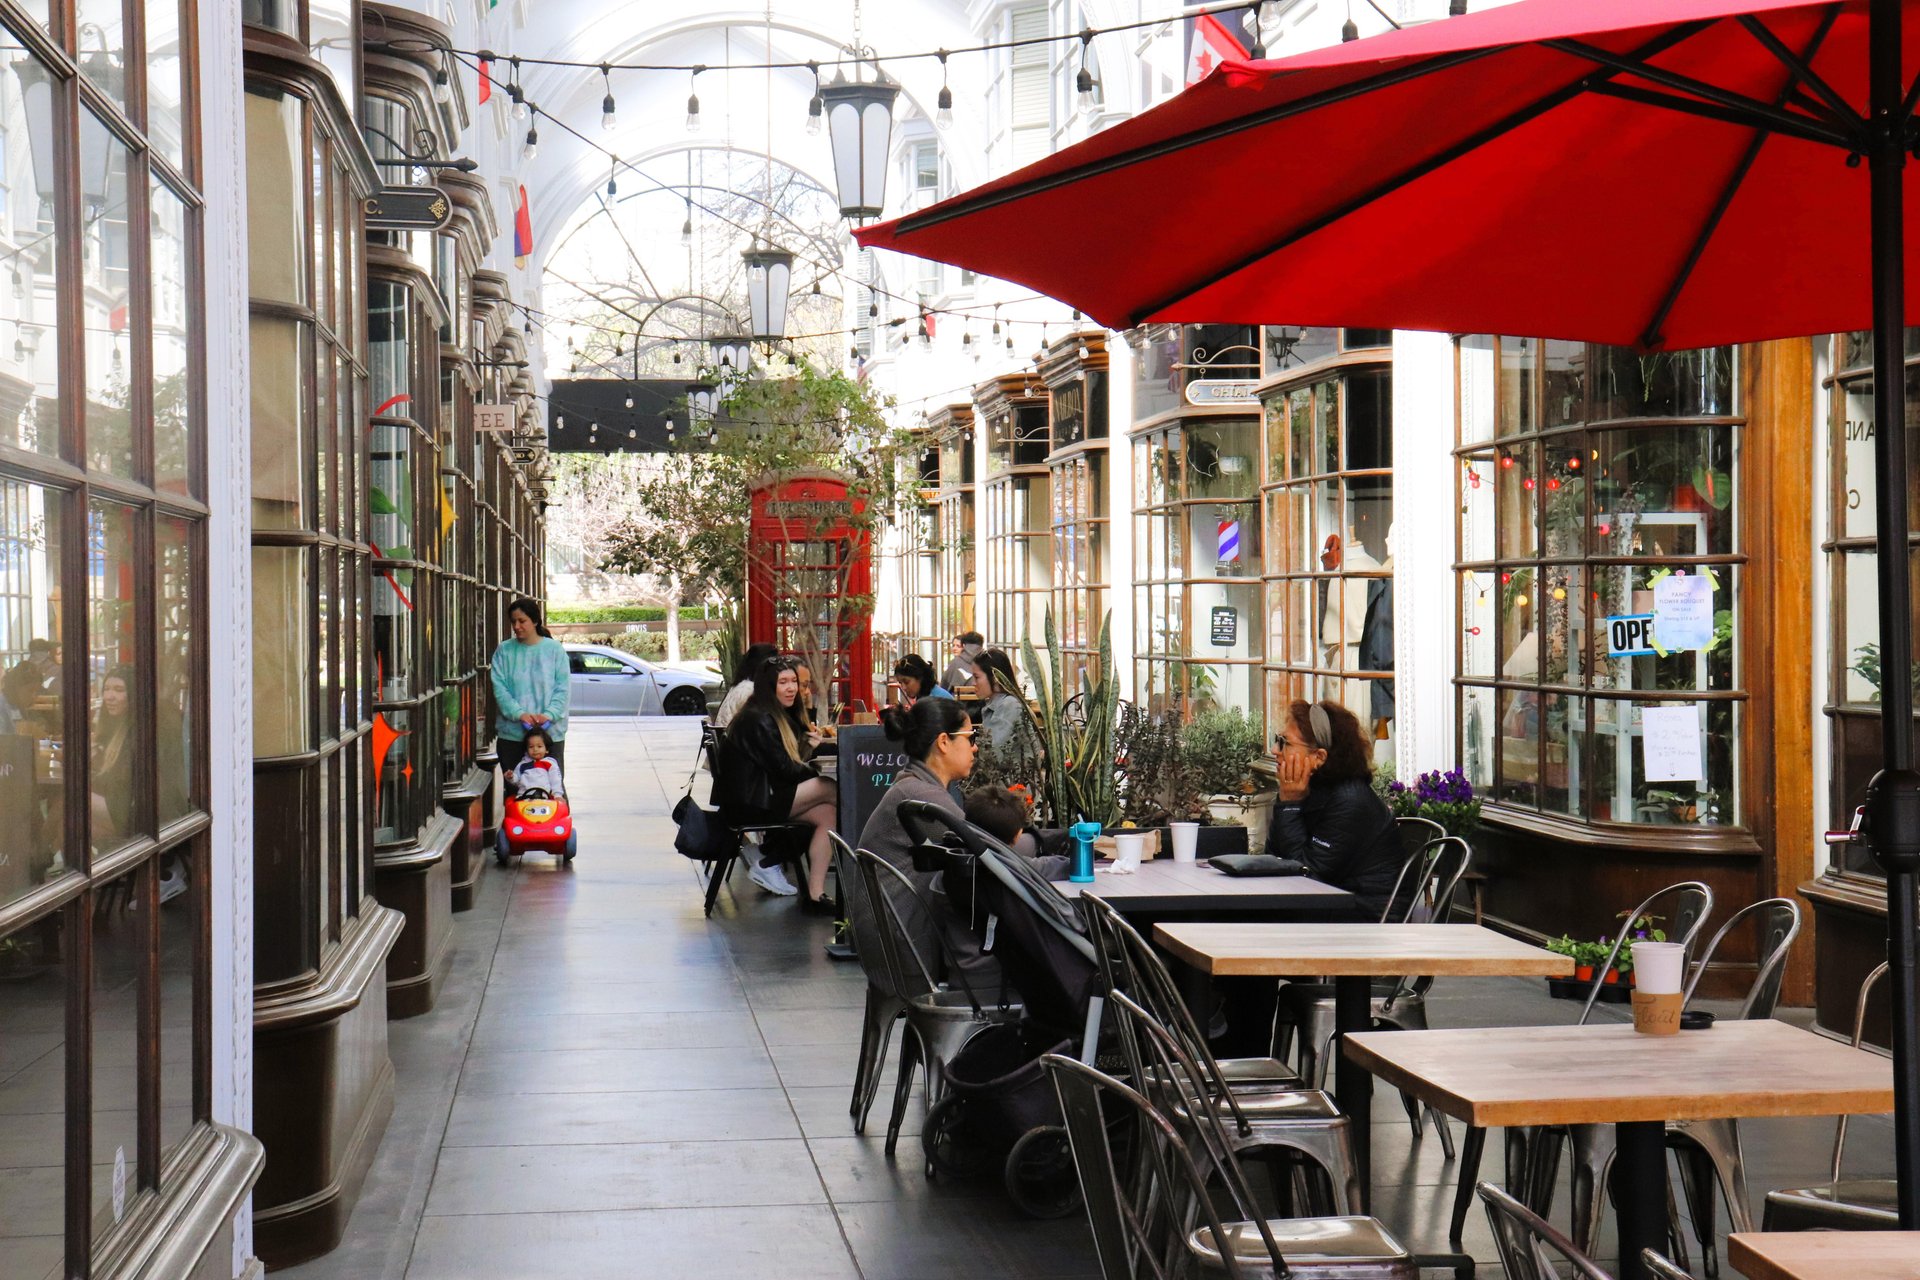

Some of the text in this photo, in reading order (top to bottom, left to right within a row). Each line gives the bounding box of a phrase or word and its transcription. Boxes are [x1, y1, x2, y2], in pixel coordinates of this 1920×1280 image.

[474, 413, 505, 428] EE
[625, 624, 648, 633] ORVIS
[1612, 619, 1654, 652] OPE
[856, 751, 906, 767] WELC
[871, 773, 896, 788] PL
